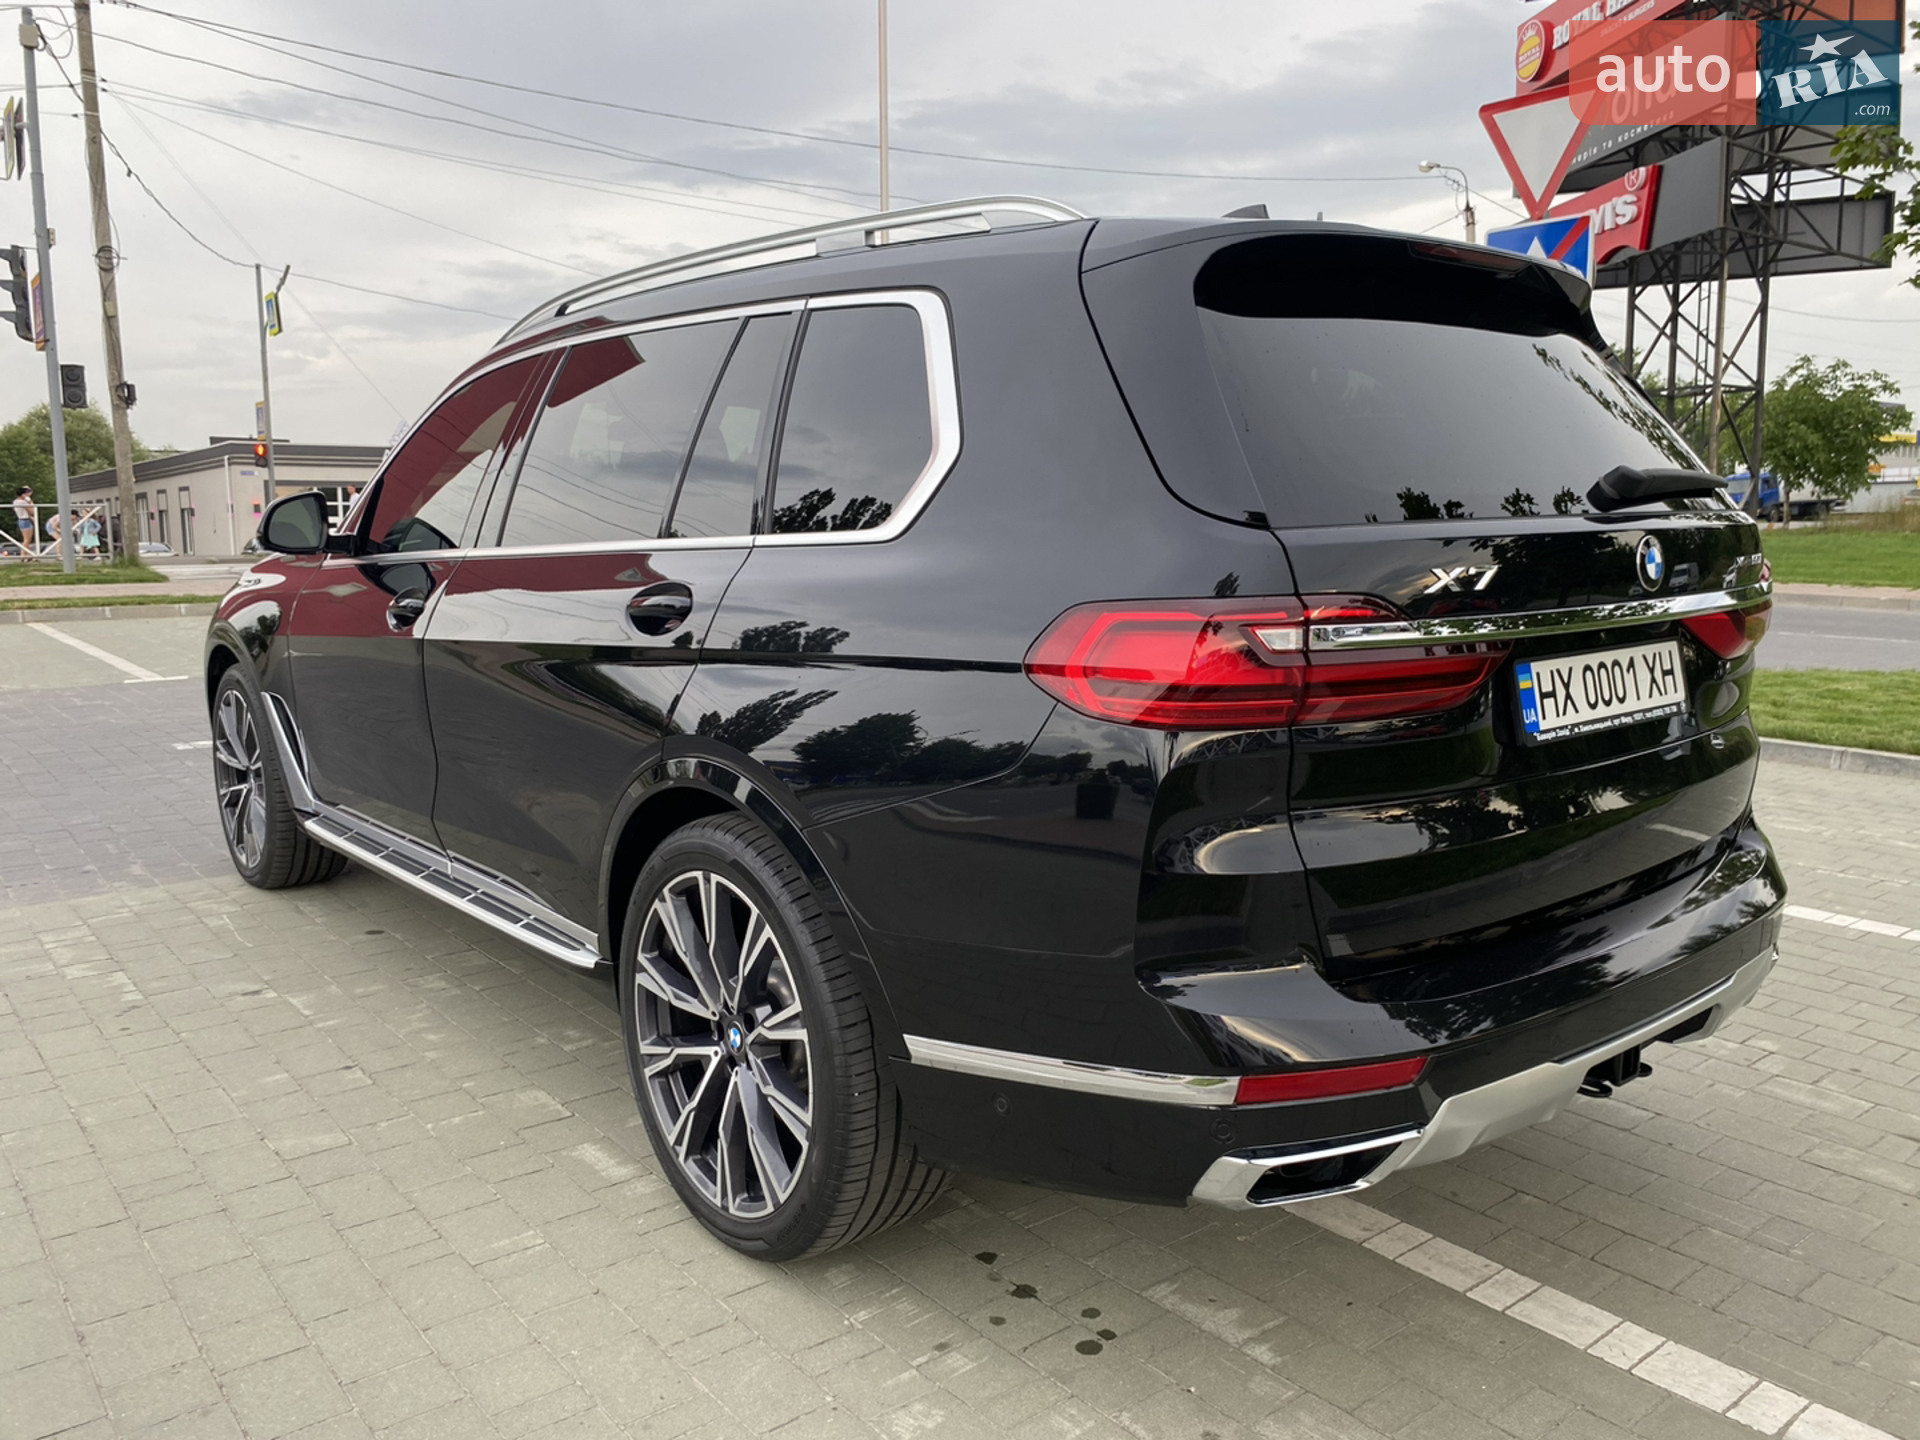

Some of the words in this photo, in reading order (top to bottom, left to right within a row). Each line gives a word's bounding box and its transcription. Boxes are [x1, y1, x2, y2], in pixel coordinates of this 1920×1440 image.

[1552, 1, 1604, 50] ROYAL
[1423, 564, 1502, 594] X7
[1536, 666, 1579, 720] HX
[1582, 656, 1640, 710] 0001
[1642, 650, 1678, 698] XH
[1523, 709, 1538, 725] UA
